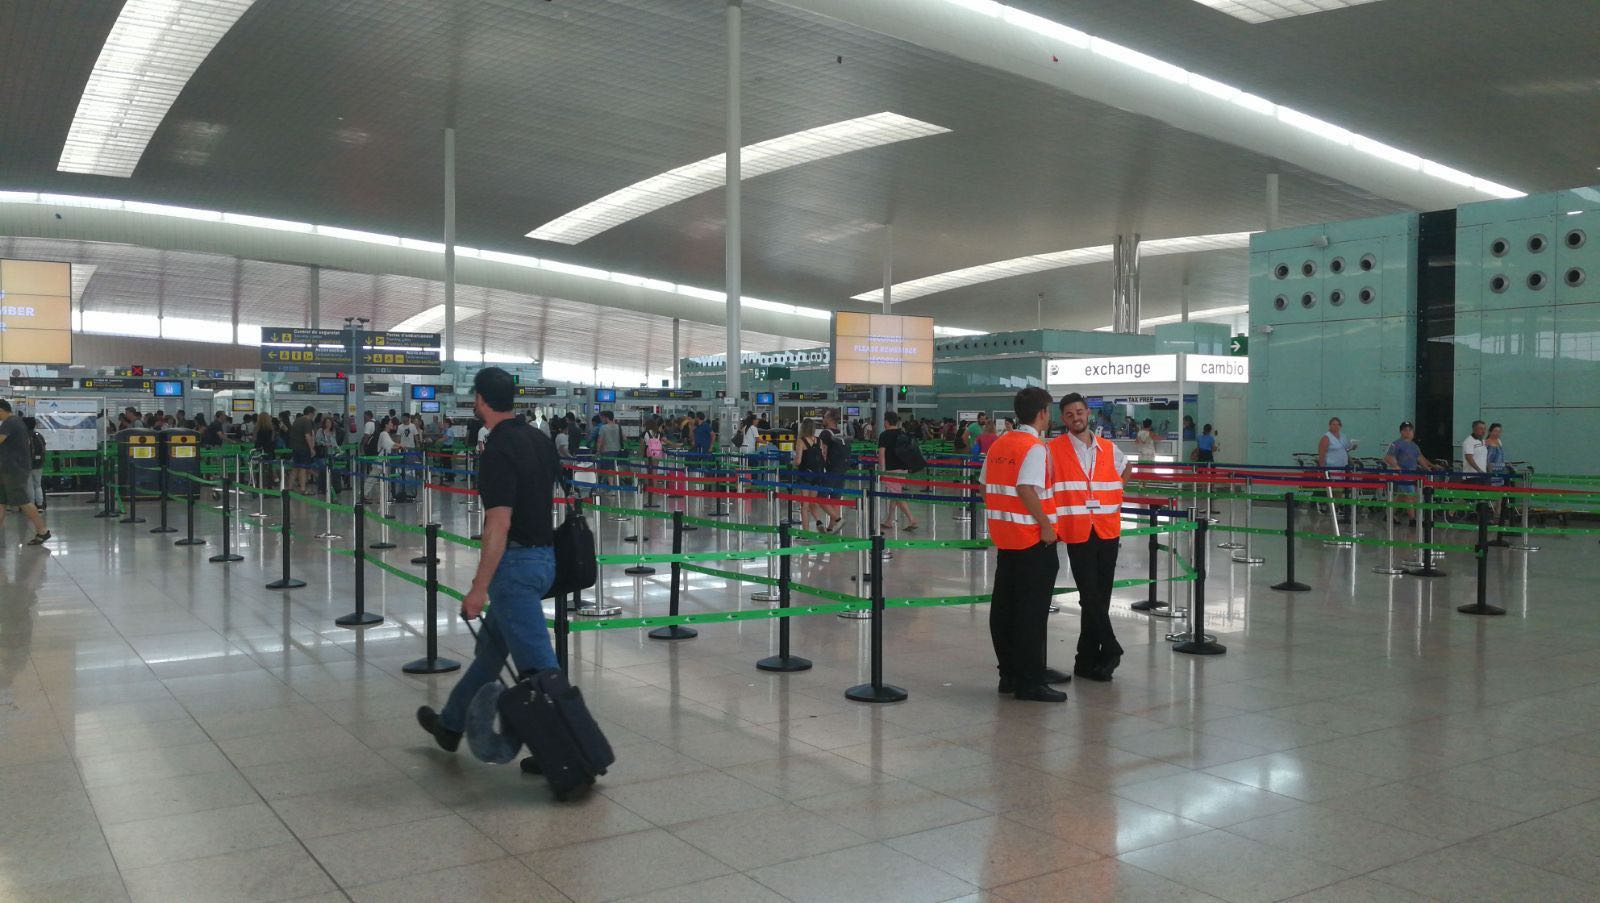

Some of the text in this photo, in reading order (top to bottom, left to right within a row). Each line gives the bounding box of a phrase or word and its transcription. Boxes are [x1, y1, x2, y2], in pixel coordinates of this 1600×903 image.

[1085, 362, 1151, 378] exchange
[1201, 360, 1244, 376] cambio
[1128, 395, 1139, 403] TAX
